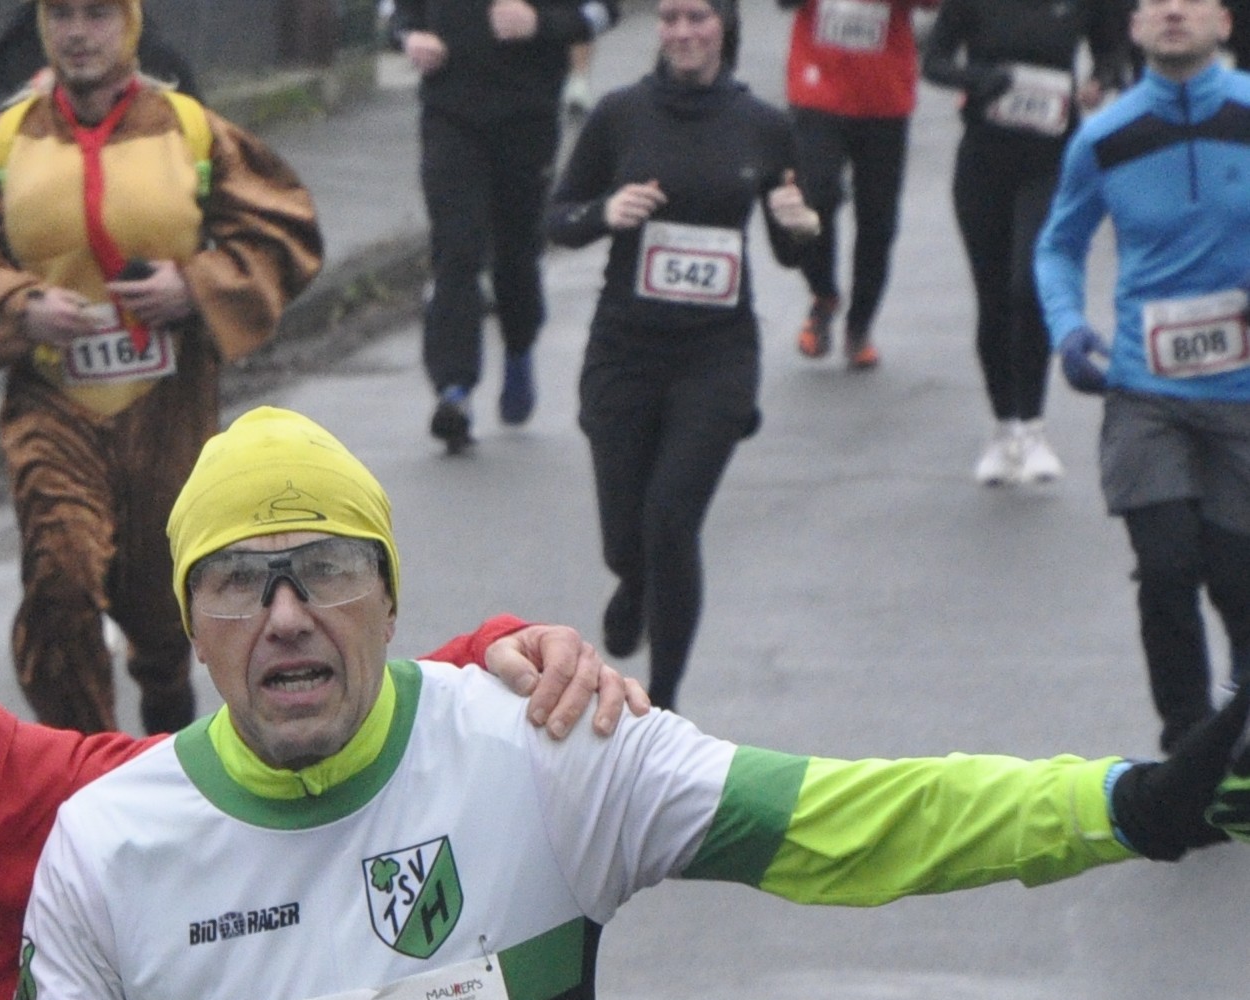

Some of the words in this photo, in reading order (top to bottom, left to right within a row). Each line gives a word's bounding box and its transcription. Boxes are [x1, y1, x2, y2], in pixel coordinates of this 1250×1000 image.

[665, 258, 718, 288] 542
[1172, 328, 1228, 362] 808
[248, 901, 300, 935] RACER
[420, 880, 449, 945] H
